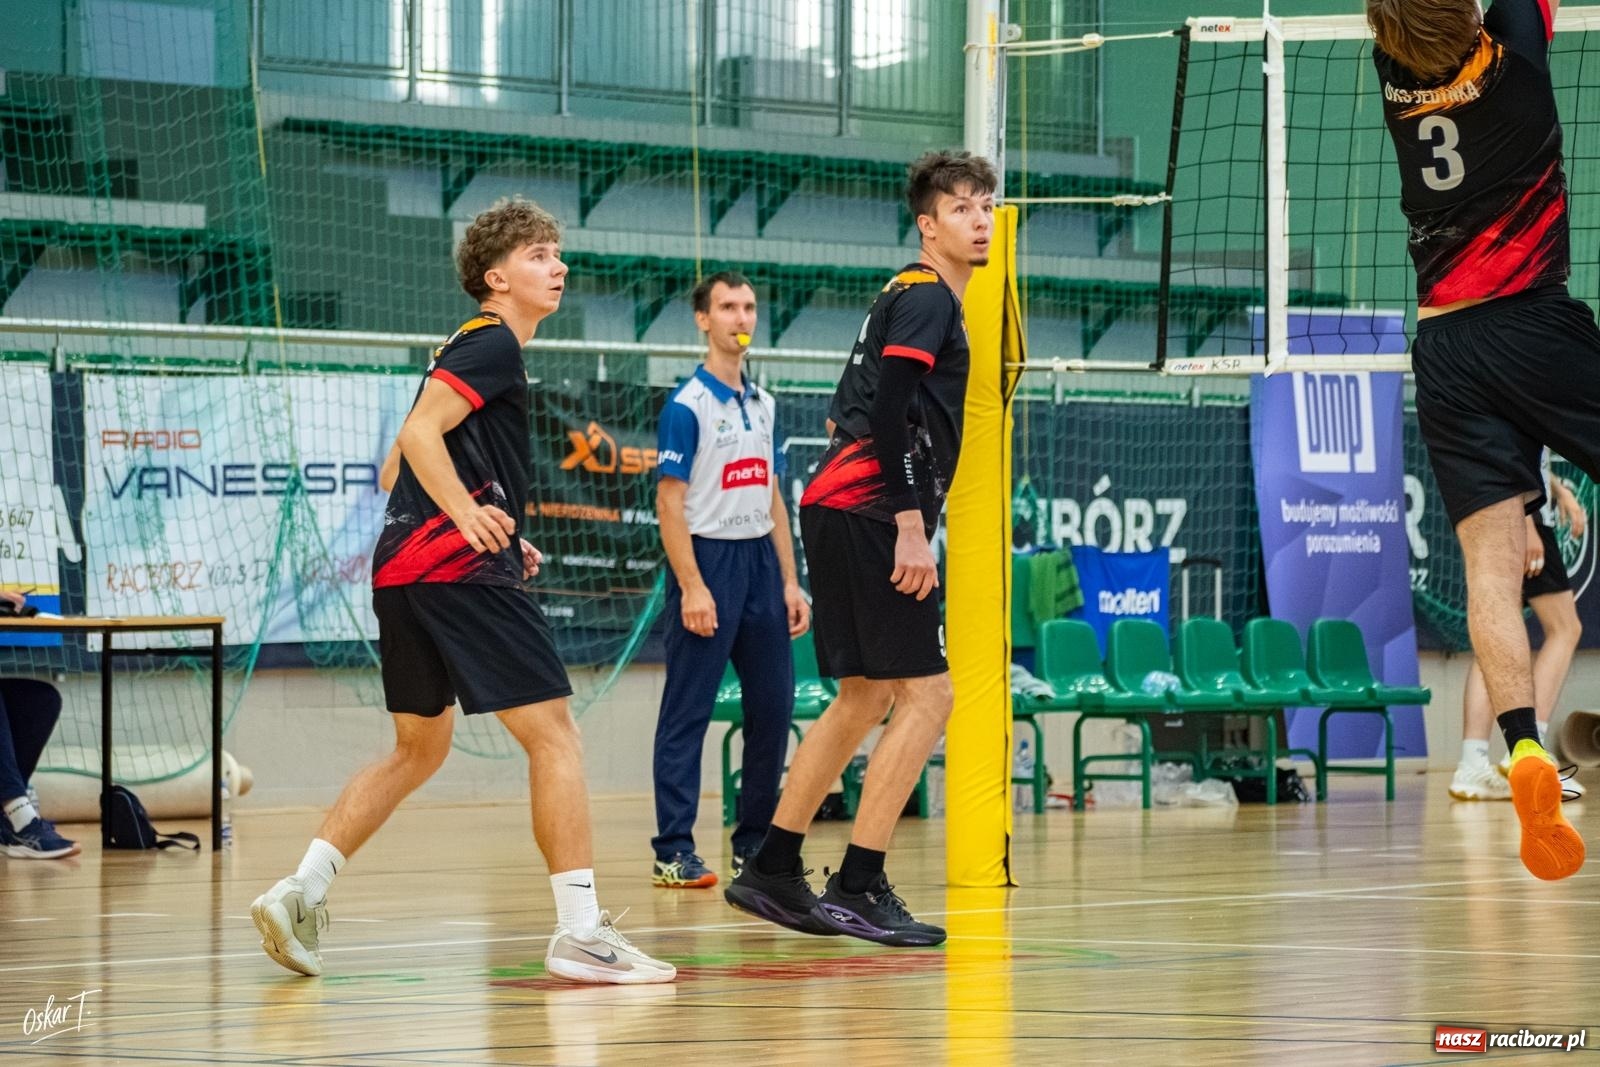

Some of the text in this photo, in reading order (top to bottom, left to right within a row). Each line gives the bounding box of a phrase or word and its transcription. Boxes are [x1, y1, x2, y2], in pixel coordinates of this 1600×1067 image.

[1200, 24, 1231, 32] netex
[1385, 82, 1413, 103] UKS
[1418, 115, 1465, 191] 3
[102, 430, 201, 450] RADIO
[103, 463, 379, 500] VANESSA
[903, 452, 914, 485] KIPSTA
[9, 508, 34, 527] 647
[1281, 498, 1399, 527] budujemy możliwości
[16, 542, 25, 559] 2
[1306, 530, 1381, 557] porozumienia
[1098, 588, 1161, 615] molten
